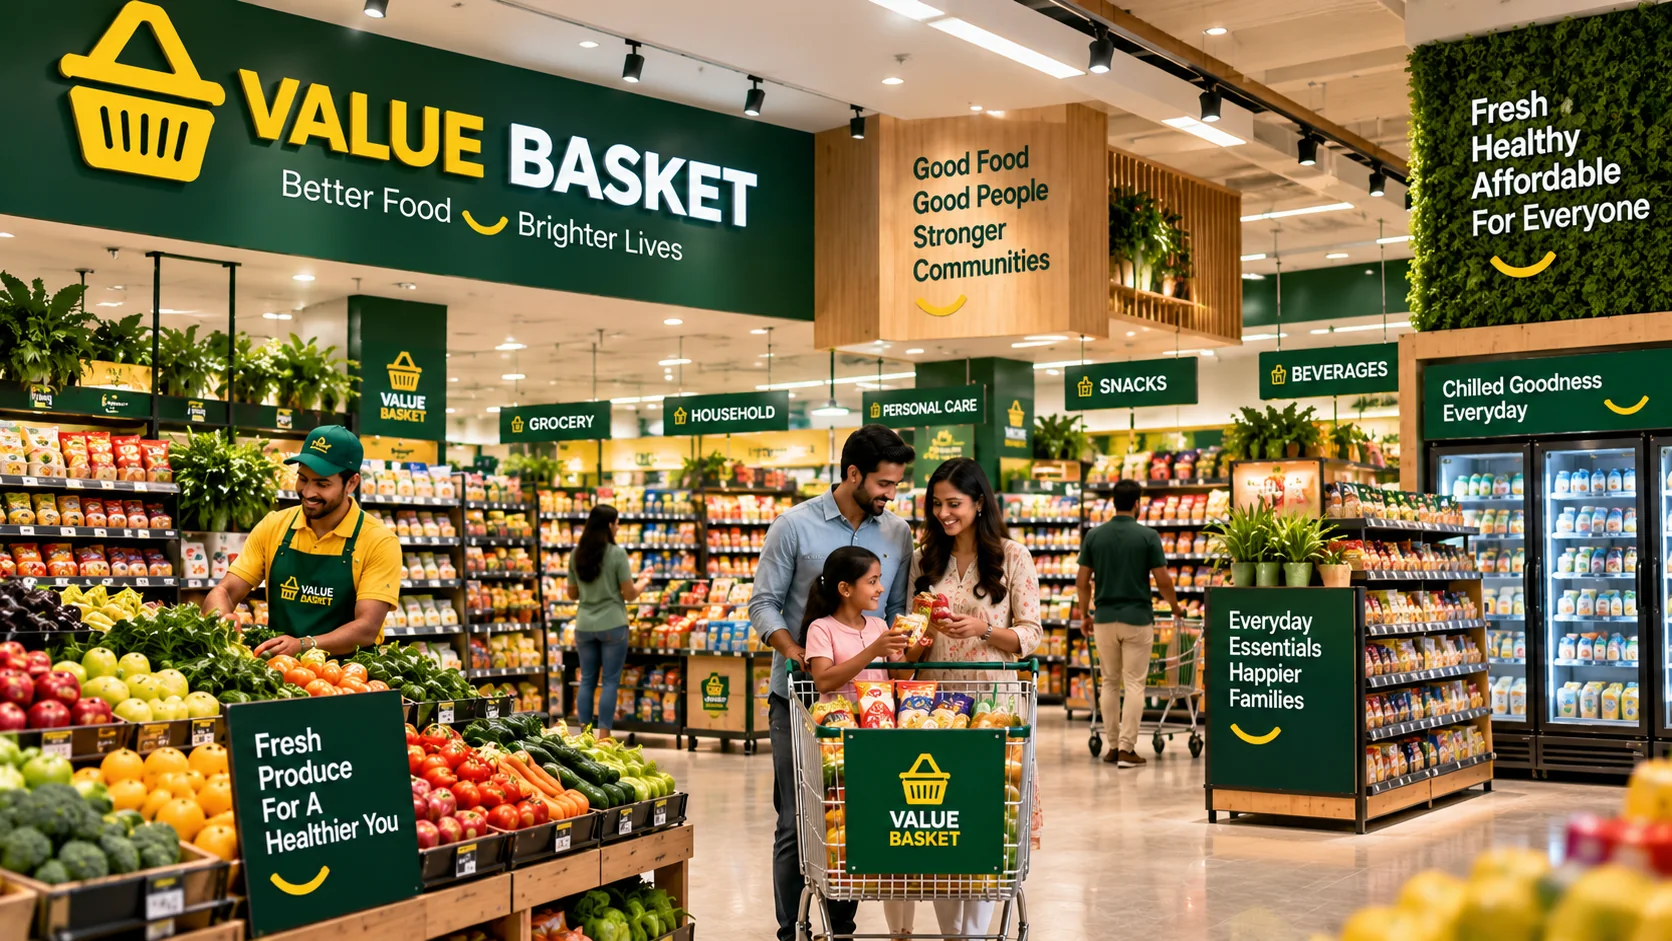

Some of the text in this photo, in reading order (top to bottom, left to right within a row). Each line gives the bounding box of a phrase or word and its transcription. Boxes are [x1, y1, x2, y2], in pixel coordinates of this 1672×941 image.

[1472, 90, 1547, 125] Fresh
[238, 69, 757, 227] VALUE BASKET
[1473, 126, 1580, 162] Healthy
[913, 145, 1029, 180] Good Food
[1471, 157, 1620, 199] Affordable
[913, 178, 1048, 214] Good People
[283, 169, 682, 260] Better Food Brighter Lives
[1473, 199, 1649, 236] For Everyone
[914, 223, 1006, 248] Stronger
[913, 249, 1050, 282] Communities
[1292, 361, 1387, 381] BEVERAGES
[1100, 376, 1167, 393] SNACKS
[1443, 373, 1602, 397] Chilled Goodness
[381, 392, 425, 409] VALUE
[883, 399, 977, 416] PERSONAL CARE
[1444, 401, 1527, 424] Everyday
[381, 408, 426, 422] BASKET
[530, 415, 594, 430] GROCERY
[692, 406, 775, 422] HOUSEHOLD
[302, 585, 333, 597] VALUE
[1230, 610, 1312, 635] Everyday
[1230, 637, 1321, 657] Essentials
[1230, 662, 1302, 686] Happier
[1230, 689, 1304, 709] Families
[255, 727, 321, 758] Fresh
[259, 760, 352, 790] Produce
[262, 792, 323, 822] For A
[890, 811, 959, 828] VALUE
[266, 812, 399, 854] Healthier You
[890, 831, 960, 846] BASKET
